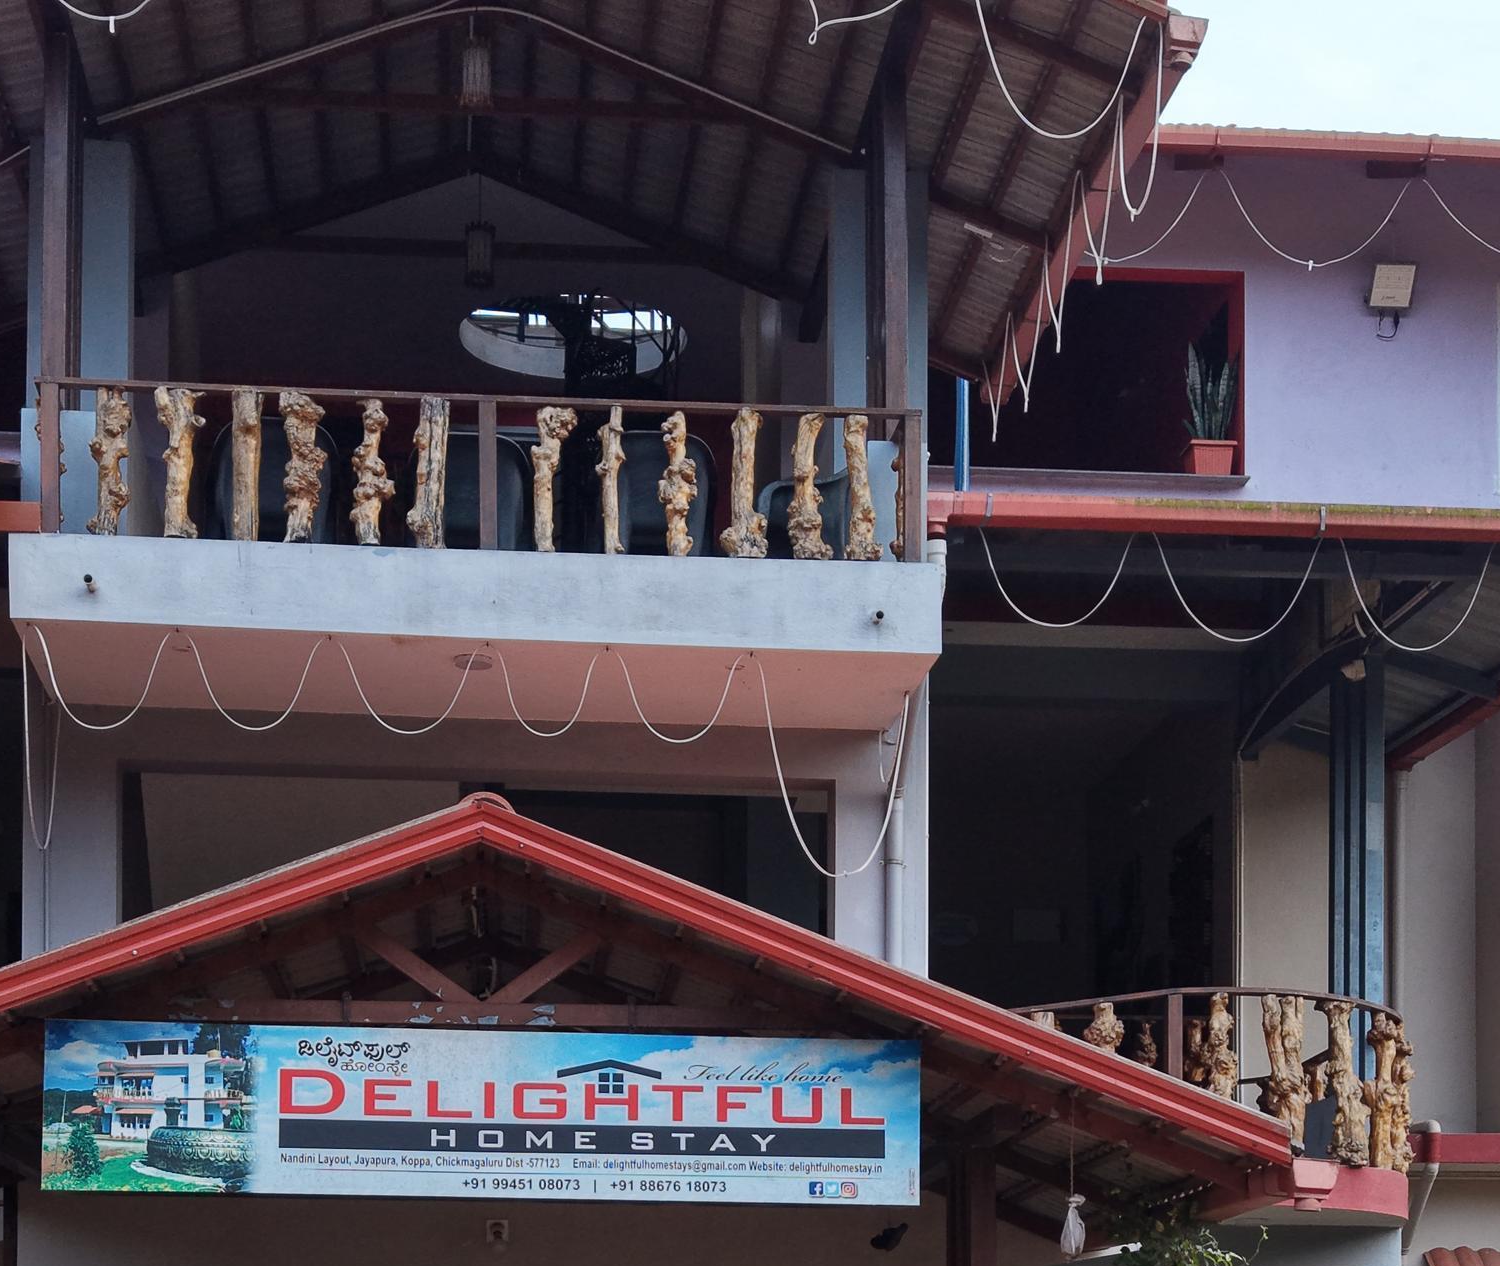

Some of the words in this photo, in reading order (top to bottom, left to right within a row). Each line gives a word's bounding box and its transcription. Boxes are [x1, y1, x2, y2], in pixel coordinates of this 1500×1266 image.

[684, 1064, 741, 1081] Feel
[740, 1062, 779, 1081] like
[783, 1062, 843, 1083] home
[279, 1069, 885, 1125] DELIGHTFUL
[430, 1129, 596, 1150] HOME
[630, 1132, 776, 1152] STAY
[280, 1153, 315, 1163] Nandini
[318, 1154, 351, 1166] Layout,
[354, 1155, 398, 1167] Jayapura,
[401, 1155, 433, 1168] Koppa,
[435, 1156, 503, 1169] Chickmagaluru
[505, 1157, 523, 1168] Dist
[573, 1158, 600, 1169] Email:
[603, 1158, 747, 1172] delightfulhomestays@gmail.com
[749, 1161, 787, 1172] Website:
[789, 1162, 882, 1175] delightfulhomestay.in
[462, 1178, 486, 1189] +91
[492, 1178, 532, 1190] 99451
[539, 1179, 580, 1190] 08073
[610, 1180, 634, 1191] +91
[639, 1180, 681, 1192] 88676
[687, 1181, 726, 1192] 18073
